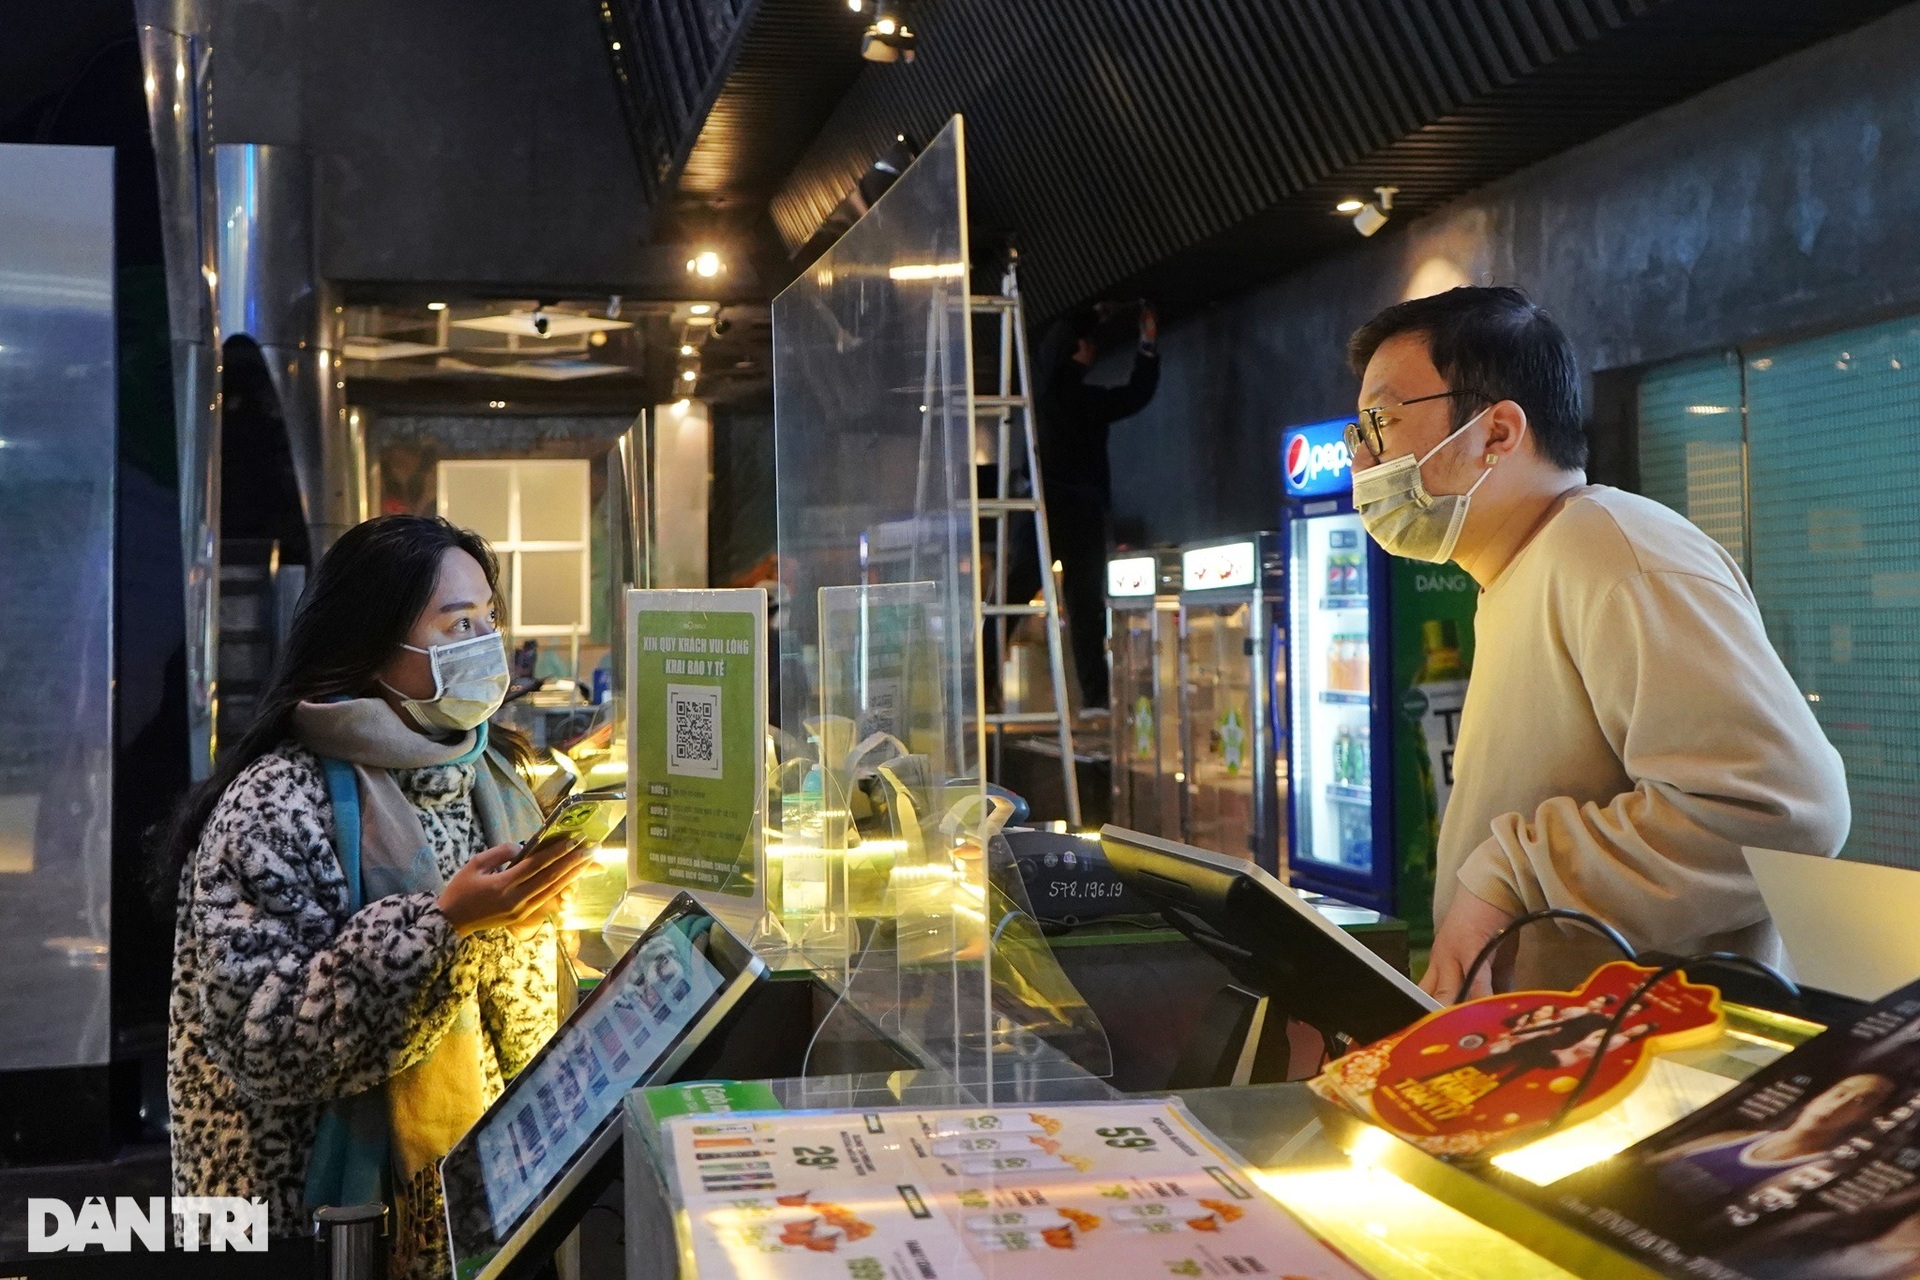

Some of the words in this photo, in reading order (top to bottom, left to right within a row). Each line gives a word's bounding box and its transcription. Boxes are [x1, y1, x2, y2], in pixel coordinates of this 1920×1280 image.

[709, 638, 724, 654] VUI
[665, 659, 685, 674] KHAI
[707, 661, 714, 676] Y
